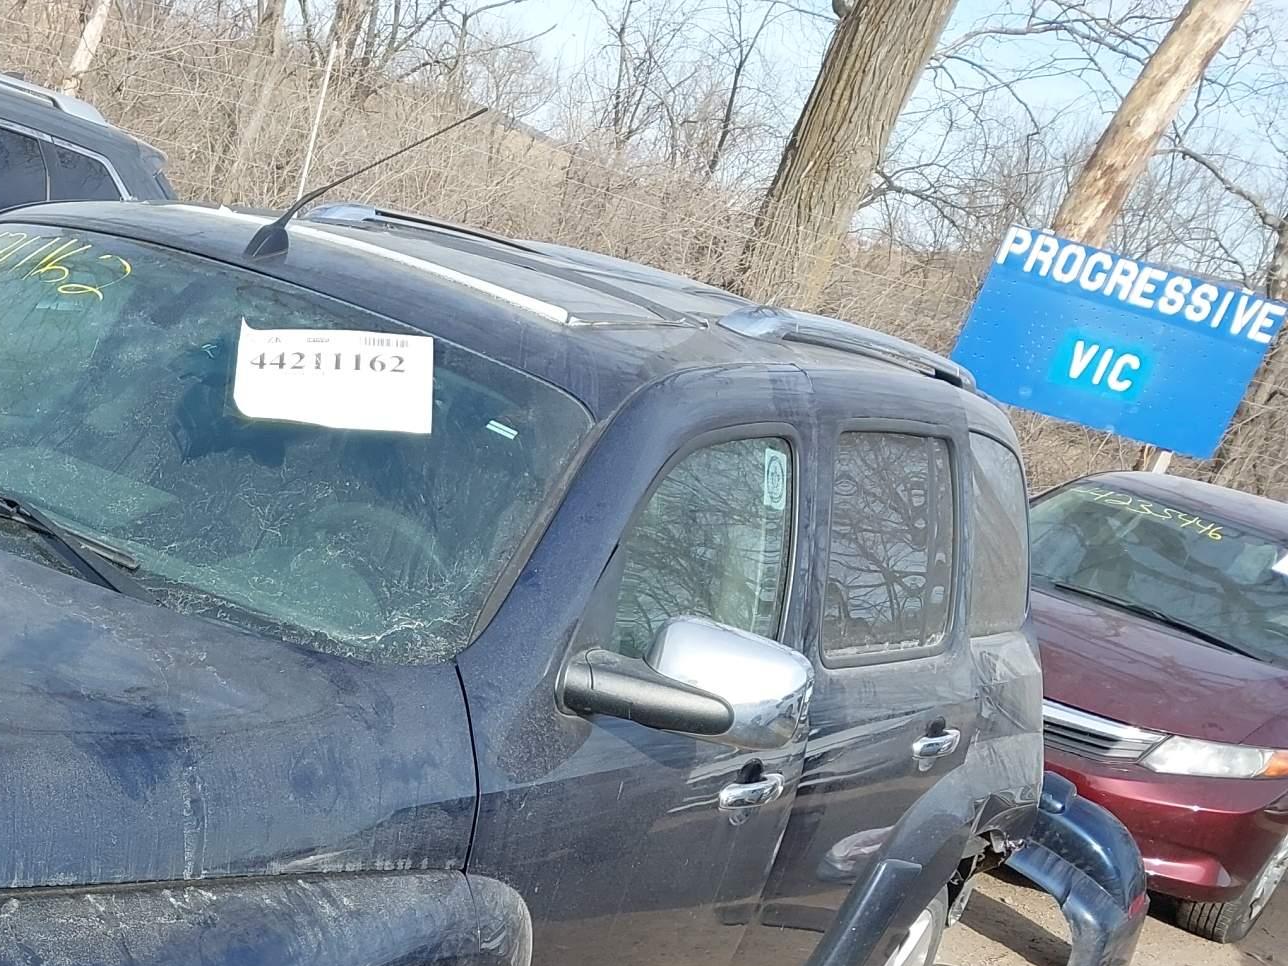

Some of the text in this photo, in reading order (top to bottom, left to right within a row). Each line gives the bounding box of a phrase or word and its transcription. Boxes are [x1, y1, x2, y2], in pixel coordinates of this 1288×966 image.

[997, 227, 1287, 344] PROGRESSIVE
[249, 352, 406, 373] 44211162
[1068, 340, 1141, 392] VIC
